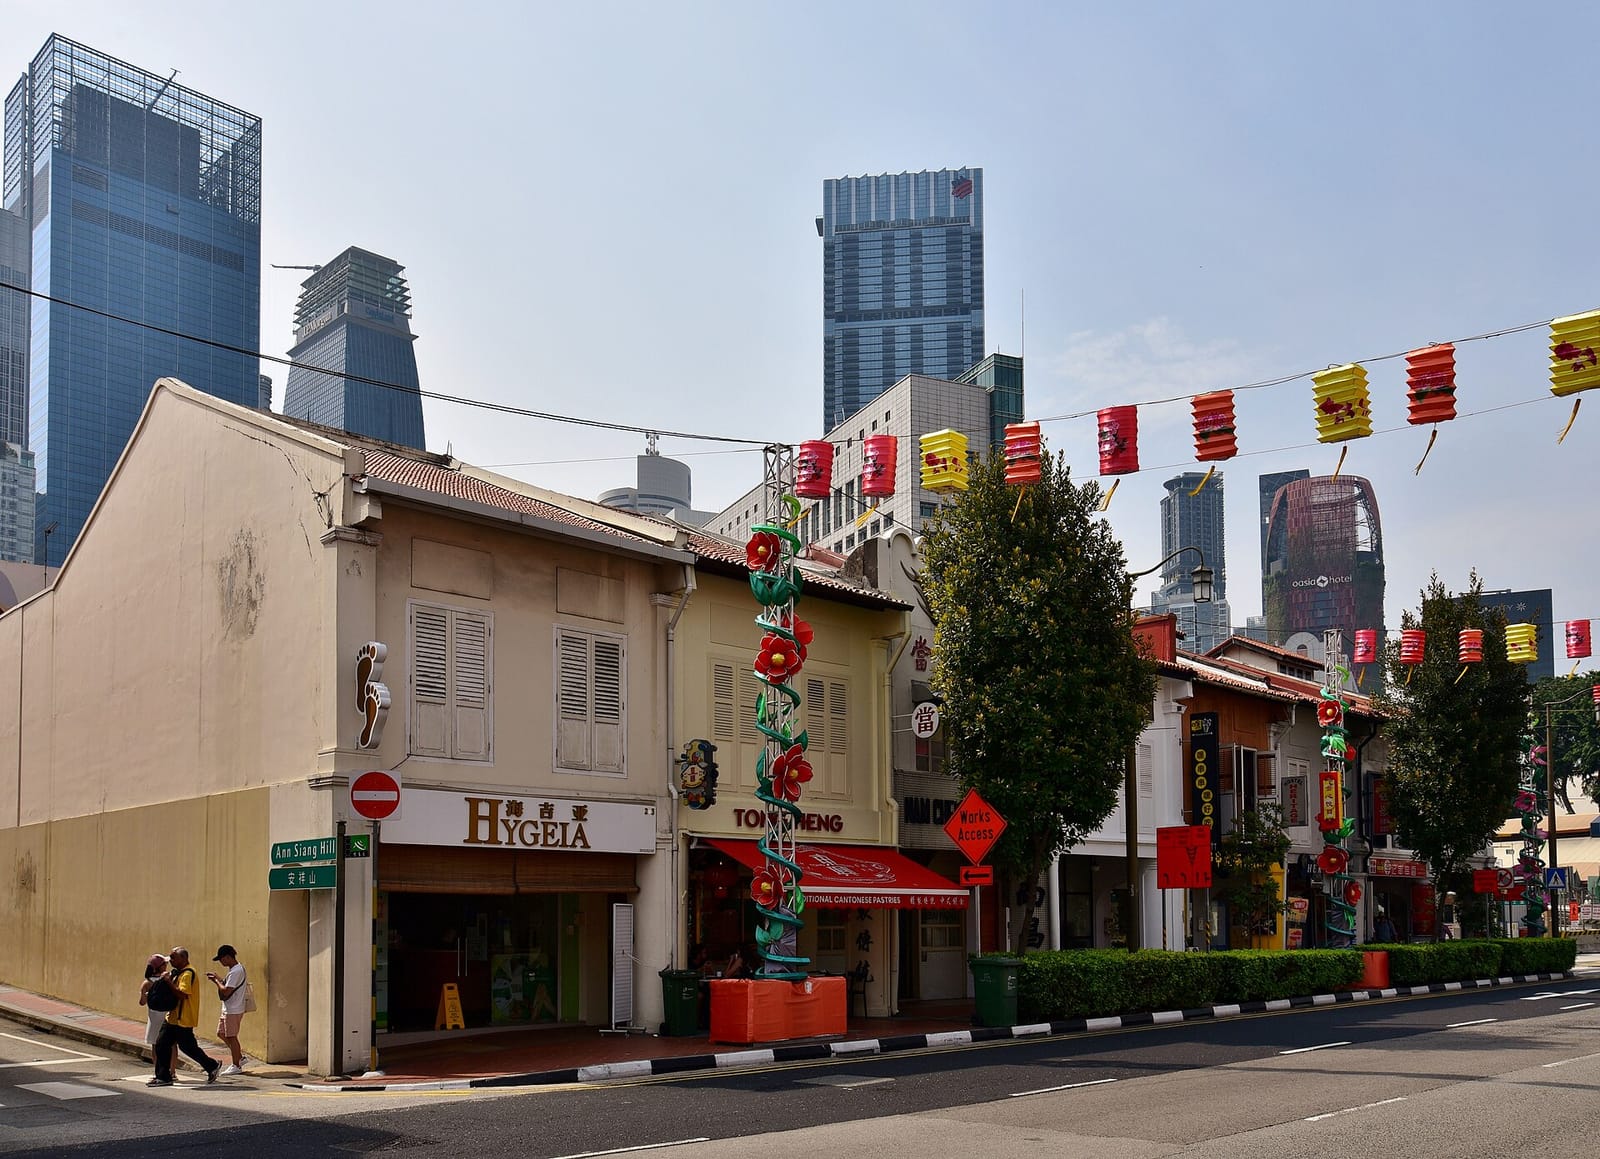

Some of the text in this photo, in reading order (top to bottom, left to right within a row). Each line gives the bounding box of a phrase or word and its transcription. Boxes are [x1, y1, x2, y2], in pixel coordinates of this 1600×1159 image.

[1292, 574, 1352, 588] oasia hotel
[914, 706, 936, 735] 當
[506, 800, 589, 822] 海吉亚
[734, 808, 792, 831] TON
[959, 809, 991, 825] Works
[463, 797, 591, 849] HYGEIA
[957, 827, 994, 843] Access
[276, 845, 291, 859] Ann
[294, 843, 317, 859] Siang
[320, 839, 335, 855] Hill
[804, 895, 900, 905] DITIONAL CANTONESE PASTRIES
